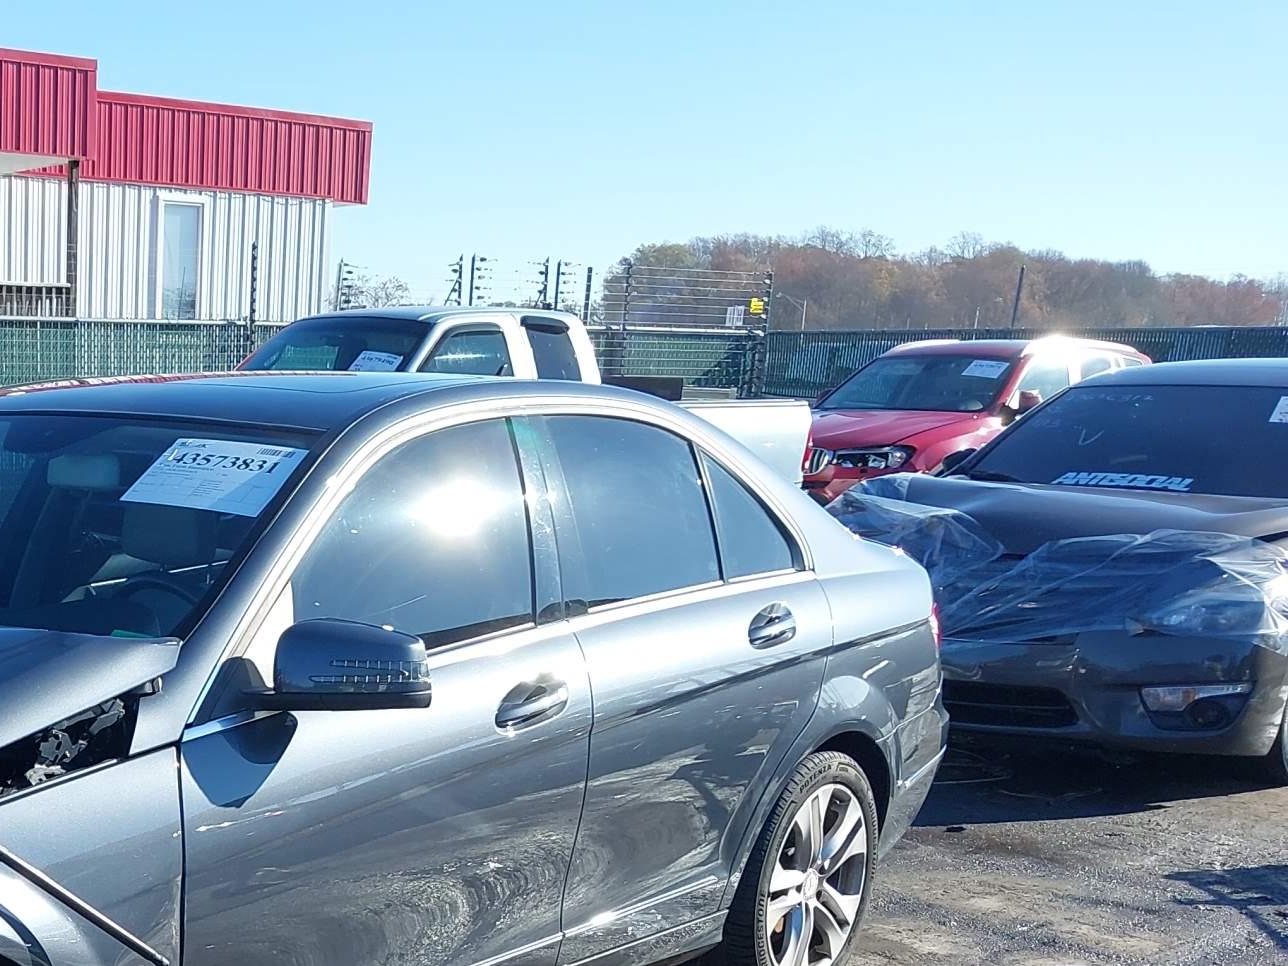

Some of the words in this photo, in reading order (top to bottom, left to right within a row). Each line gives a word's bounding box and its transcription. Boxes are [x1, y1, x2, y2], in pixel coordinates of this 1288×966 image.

[168, 451, 281, 474] 43573831
[1051, 472, 1194, 491] ANTISOCIAL
[799, 764, 832, 794] POTENZA
